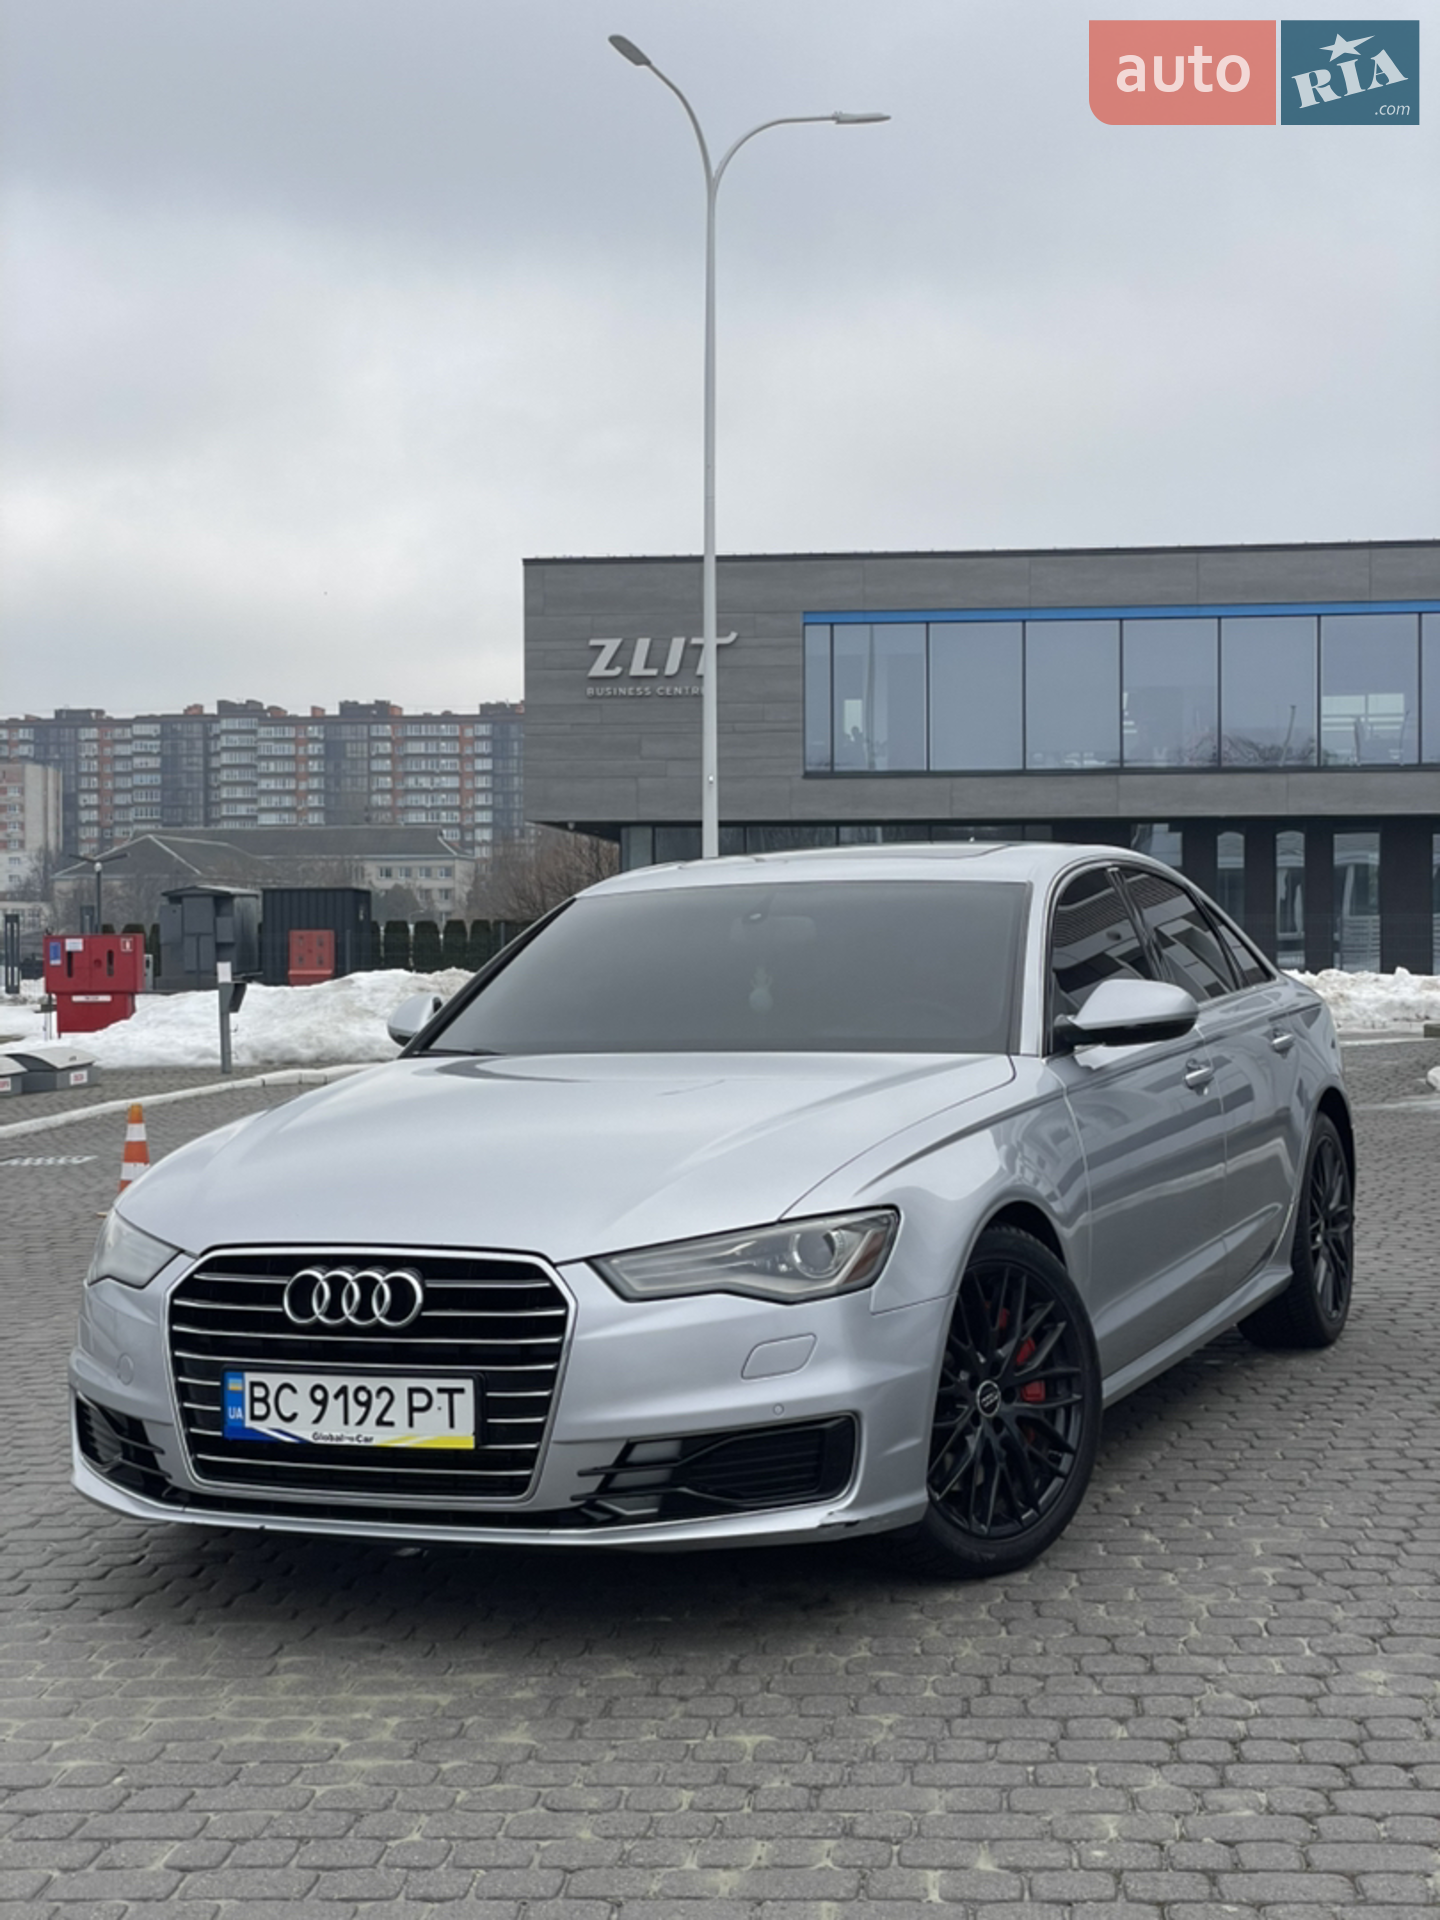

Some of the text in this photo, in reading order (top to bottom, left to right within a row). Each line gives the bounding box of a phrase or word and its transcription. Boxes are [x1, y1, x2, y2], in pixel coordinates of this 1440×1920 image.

[587, 631, 738, 678] ZLIT
[586, 685, 706, 697] BUSINESS CENTR
[228, 1405, 243, 1420] UA
[249, 1381, 466, 1429] BC 9192 PT
